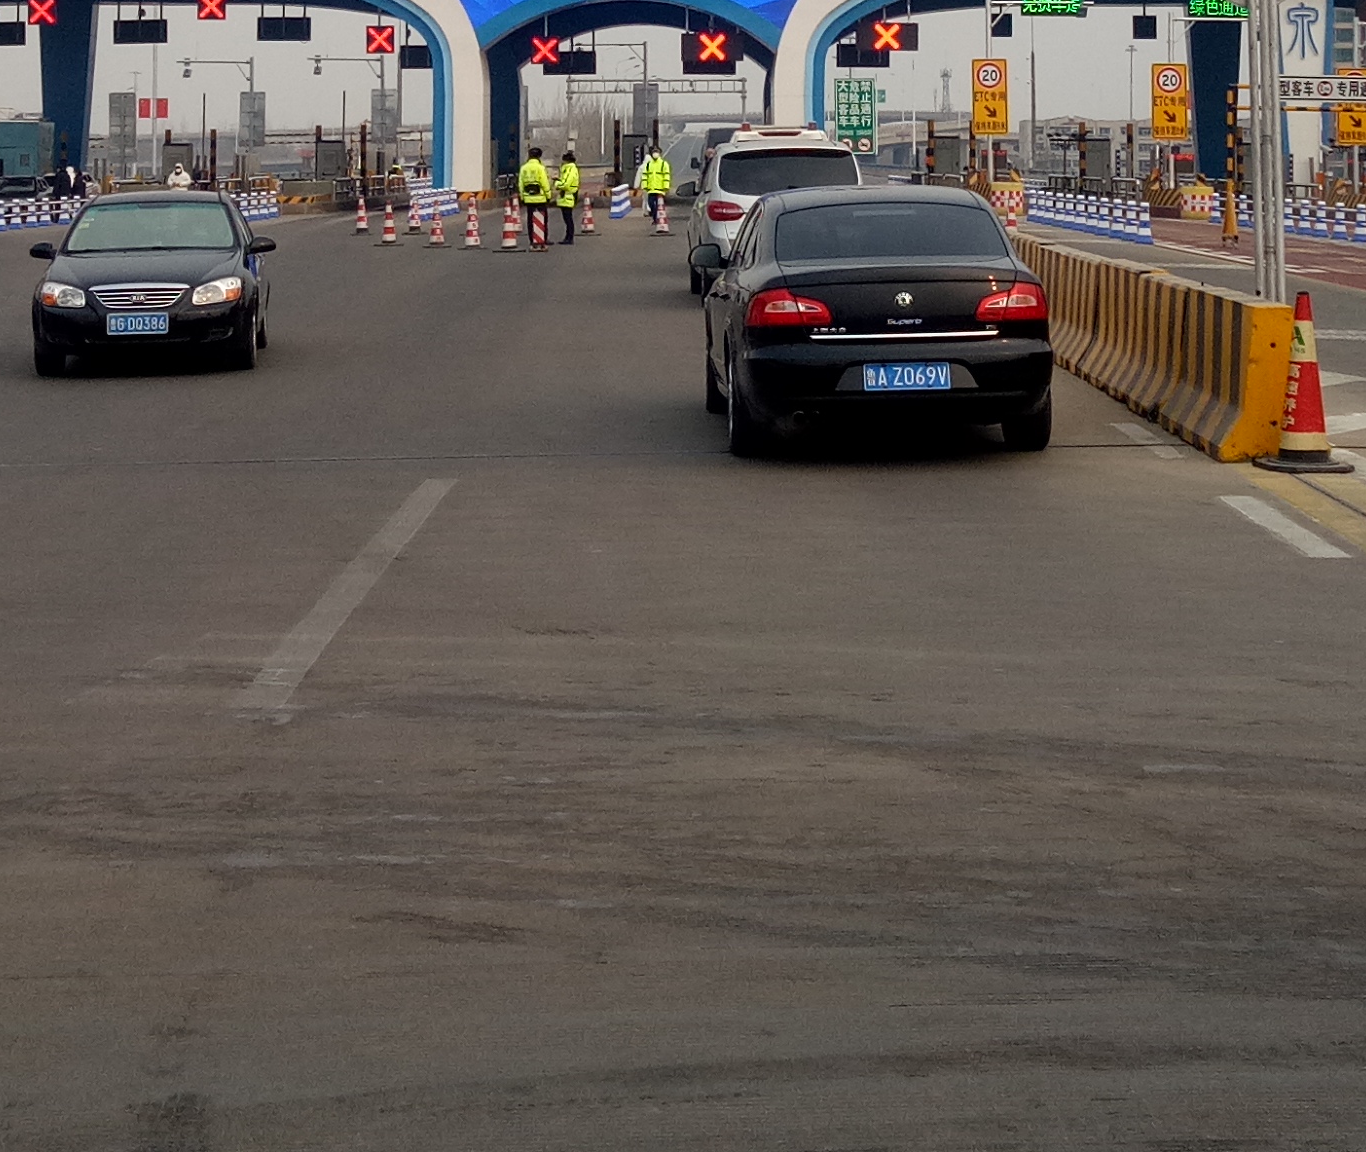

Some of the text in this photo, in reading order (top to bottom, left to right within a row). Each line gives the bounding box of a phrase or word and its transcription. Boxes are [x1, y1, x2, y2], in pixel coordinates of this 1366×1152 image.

[982, 69, 998, 82] 20
[1161, 74, 1178, 87] 20
[837, 80, 849, 127] 大型客车
[860, 80, 872, 127] 禁止通行
